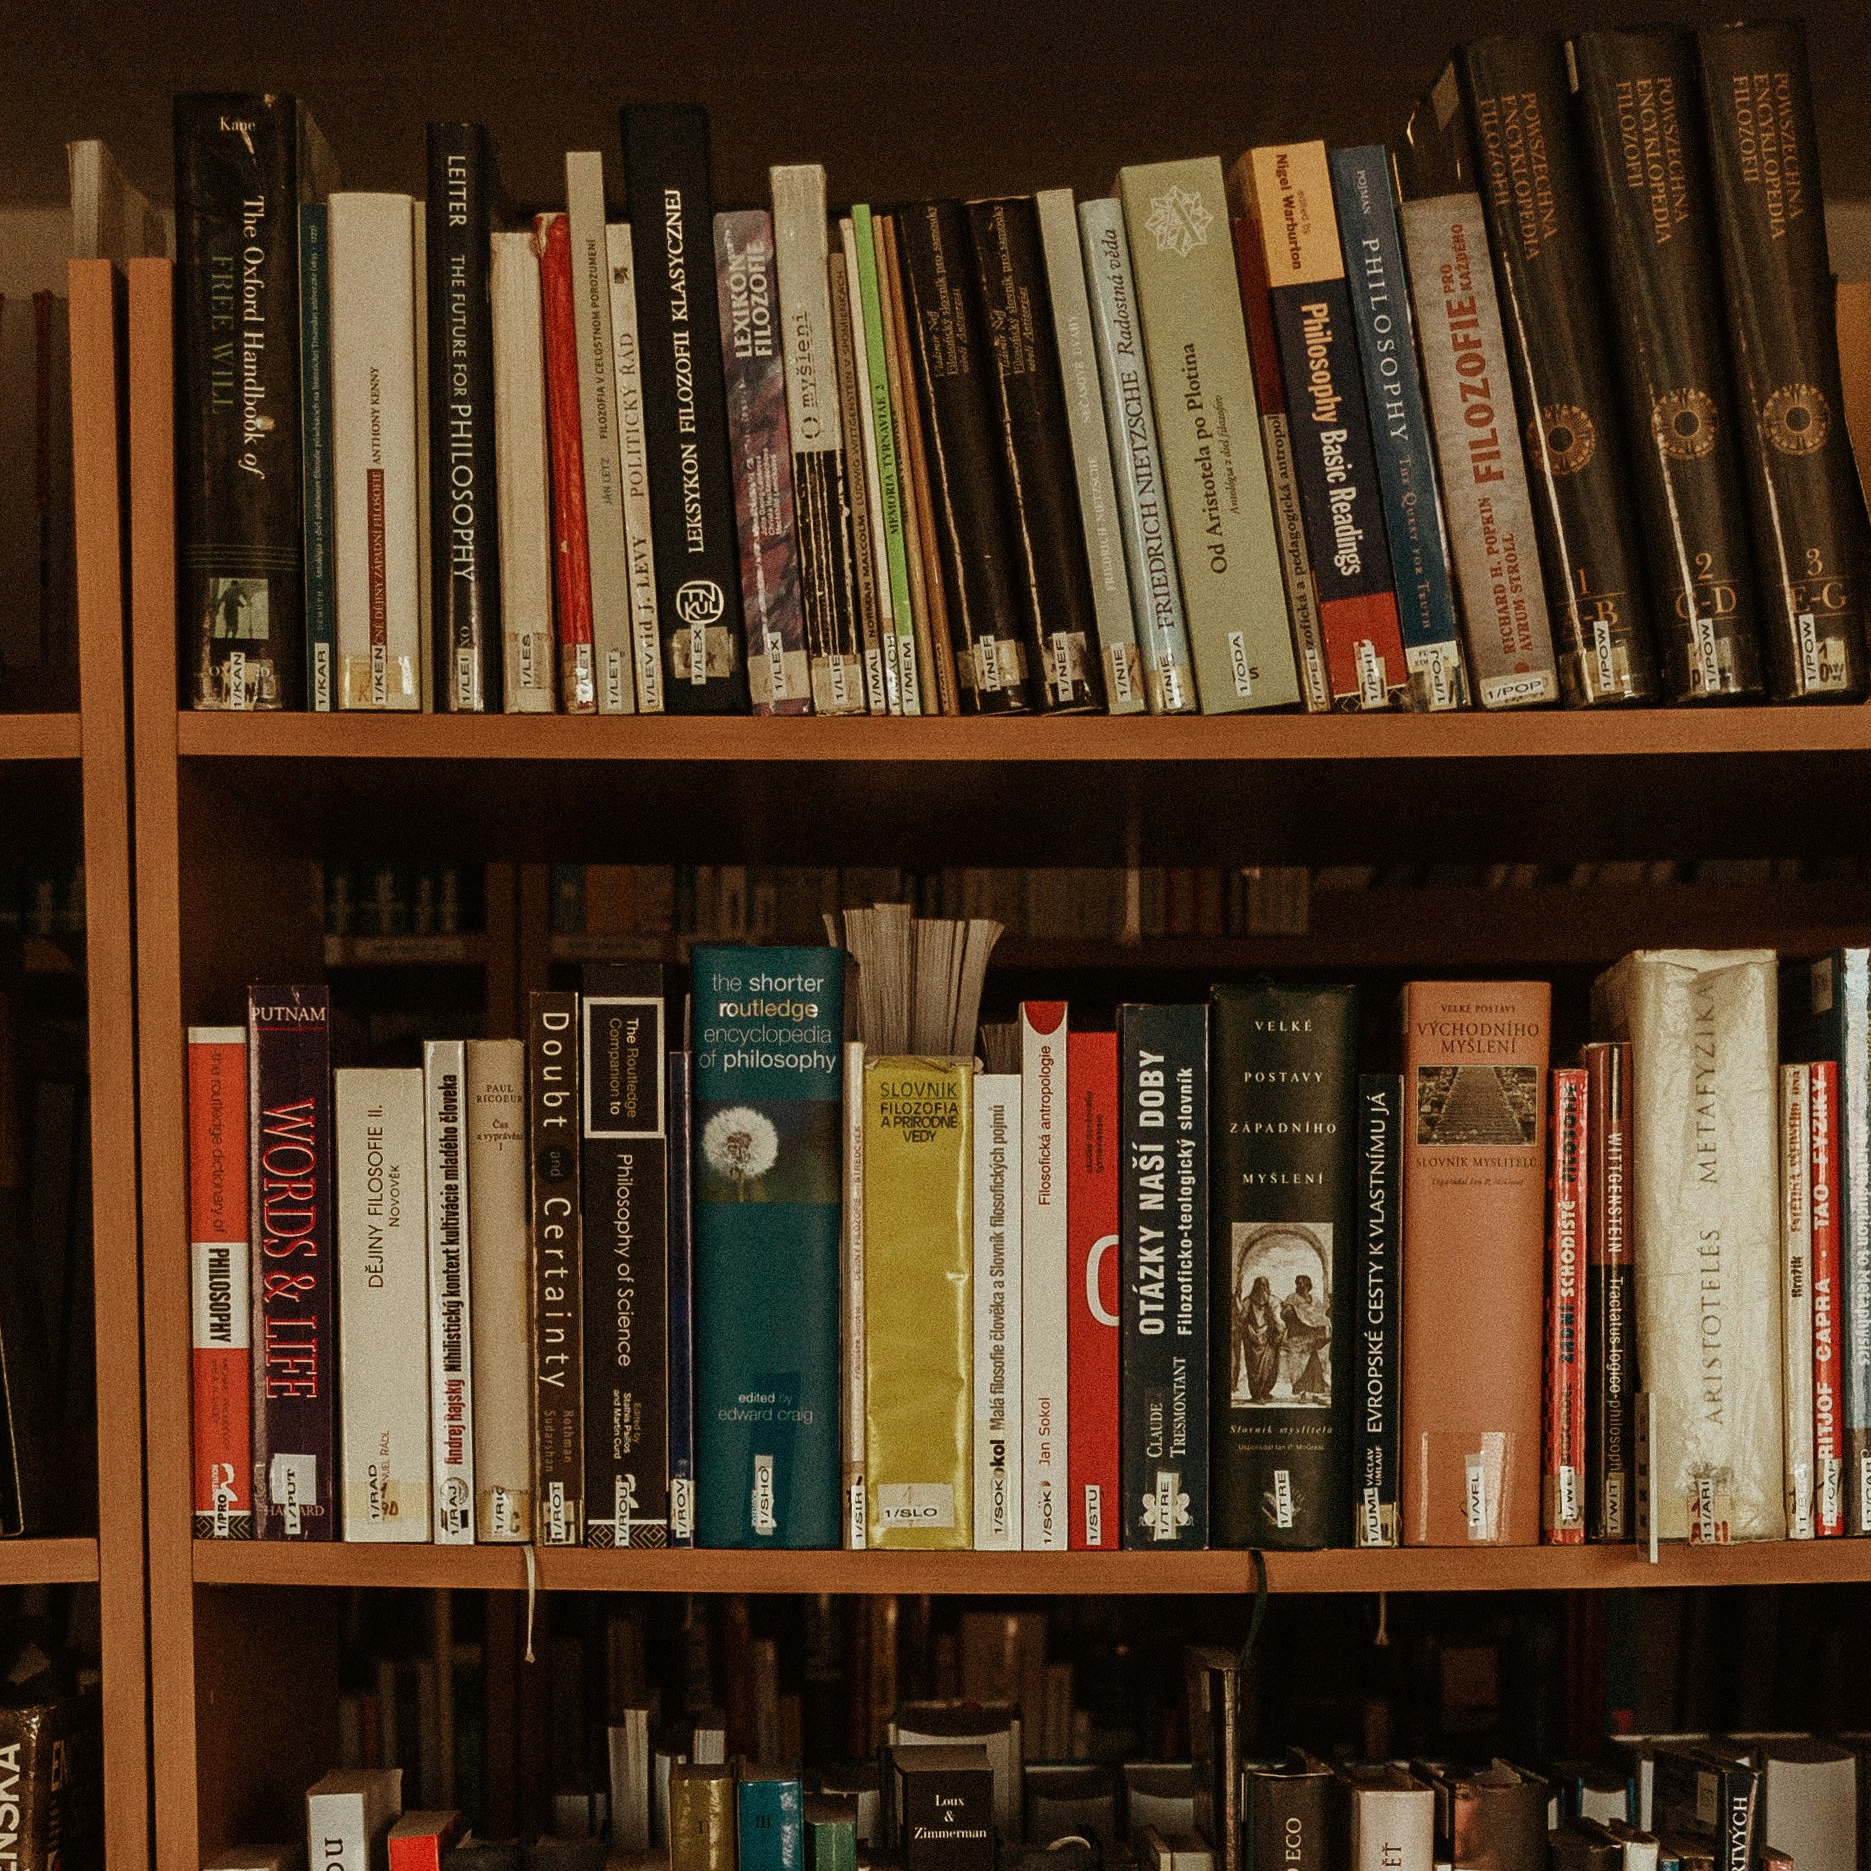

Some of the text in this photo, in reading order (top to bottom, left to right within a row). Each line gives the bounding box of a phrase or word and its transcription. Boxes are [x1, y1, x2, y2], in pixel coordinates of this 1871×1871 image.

[448, 155, 466, 225] LEITER
[238, 195, 265, 479] The Oxford Handbook of
[665, 190, 703, 552] LEKSYKON FILOZOFII KLASYCZNEJ
[1444, 295, 1504, 483] FILOZOFIE
[450, 405, 474, 583] PHILOSOPHY
[1181, 343, 1226, 573] Od Aristotela po Plotina
[1303, 303, 1368, 576] Philosophy Basic Readings
[1486, 679, 1543, 701] 1/POP
[542, 1012, 569, 1126] Doubt
[699, 1049, 837, 1075] of philosophy
[703, 1024, 832, 1047] encyclopedia
[713, 974, 823, 991] the shorter
[719, 1000, 818, 1020] routledge
[263, 1099, 316, 1398] WORDS & LIFE
[1134, 1050, 1163, 1334] OTÁZKY NAŠÍ DOBY
[537, 1197, 573, 1386] Certainty
